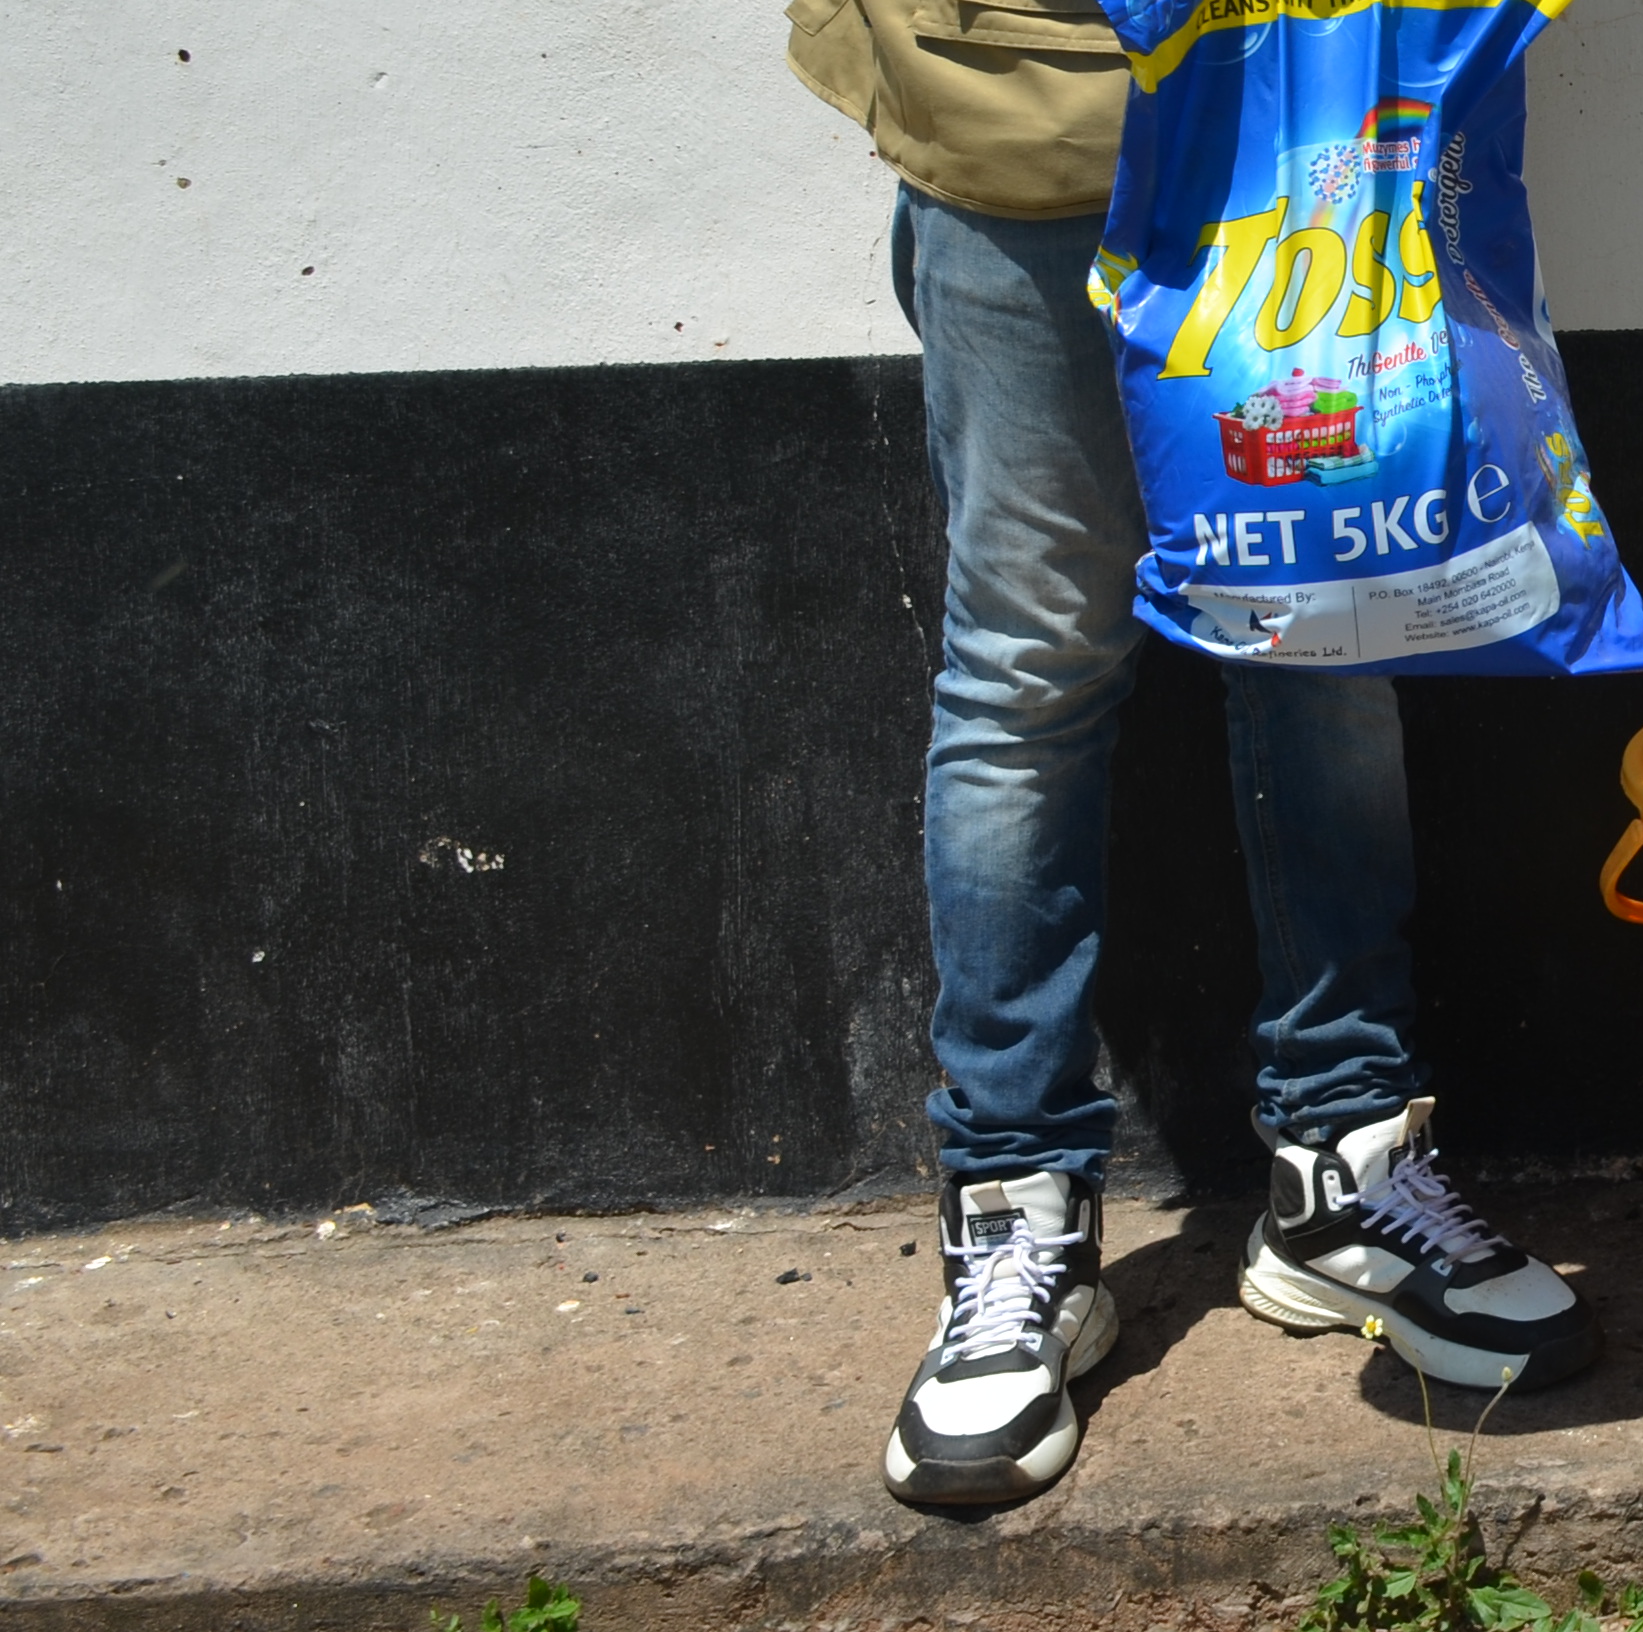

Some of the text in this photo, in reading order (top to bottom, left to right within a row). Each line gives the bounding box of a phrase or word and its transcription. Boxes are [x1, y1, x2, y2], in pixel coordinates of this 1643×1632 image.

[1371, 341, 1428, 374] Gentle
[1379, 386, 1403, 402] Non
[1373, 397, 1427, 427] Synthetic
[1193, 489, 1451, 567] NET 5KG
[1369, 591, 1390, 600] P.O.
[1394, 587, 1414, 598] Box
[1417, 566, 1511, 607] Main Mombasa Road
[1462, 595, 1479, 608] 020
[1323, 646, 1347, 658] Ltd.
[974, 1217, 1016, 1235] SPORT
